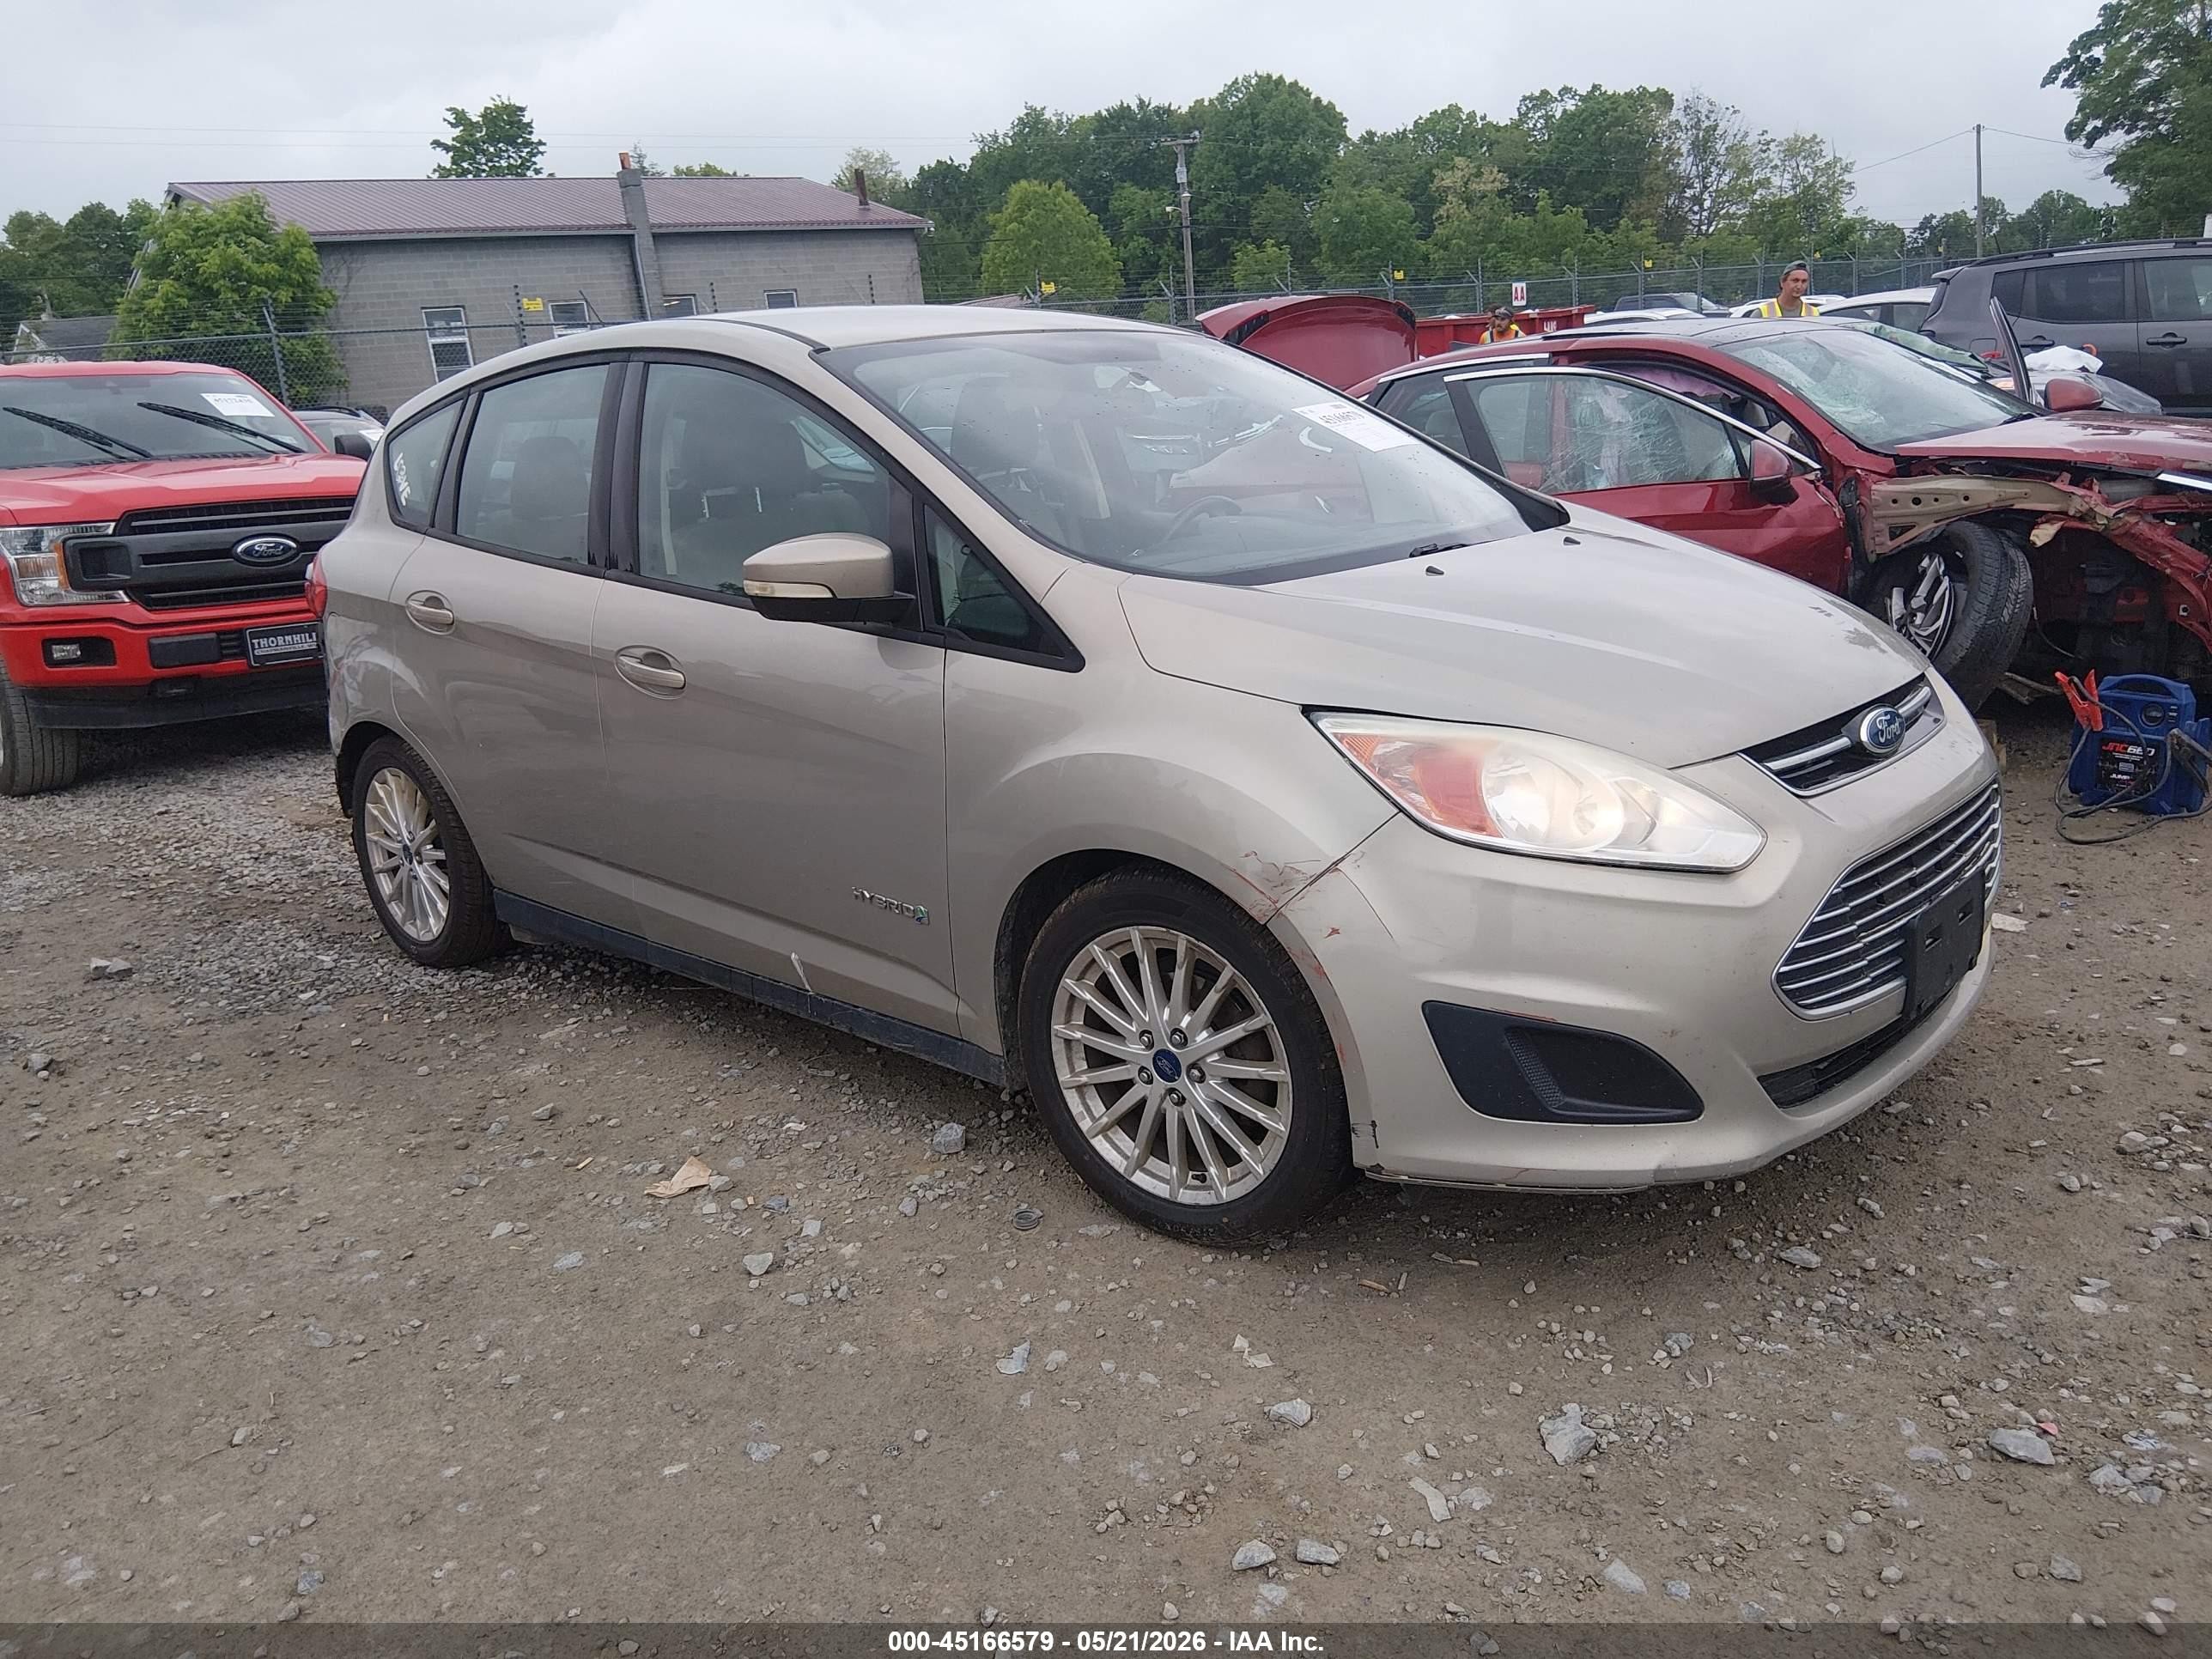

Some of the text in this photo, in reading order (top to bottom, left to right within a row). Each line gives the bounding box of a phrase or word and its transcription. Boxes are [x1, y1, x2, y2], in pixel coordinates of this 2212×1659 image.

[252, 543, 284, 557] Ford
[1875, 714, 1901, 744] Ford
[851, 886, 915, 919] HYBRID
